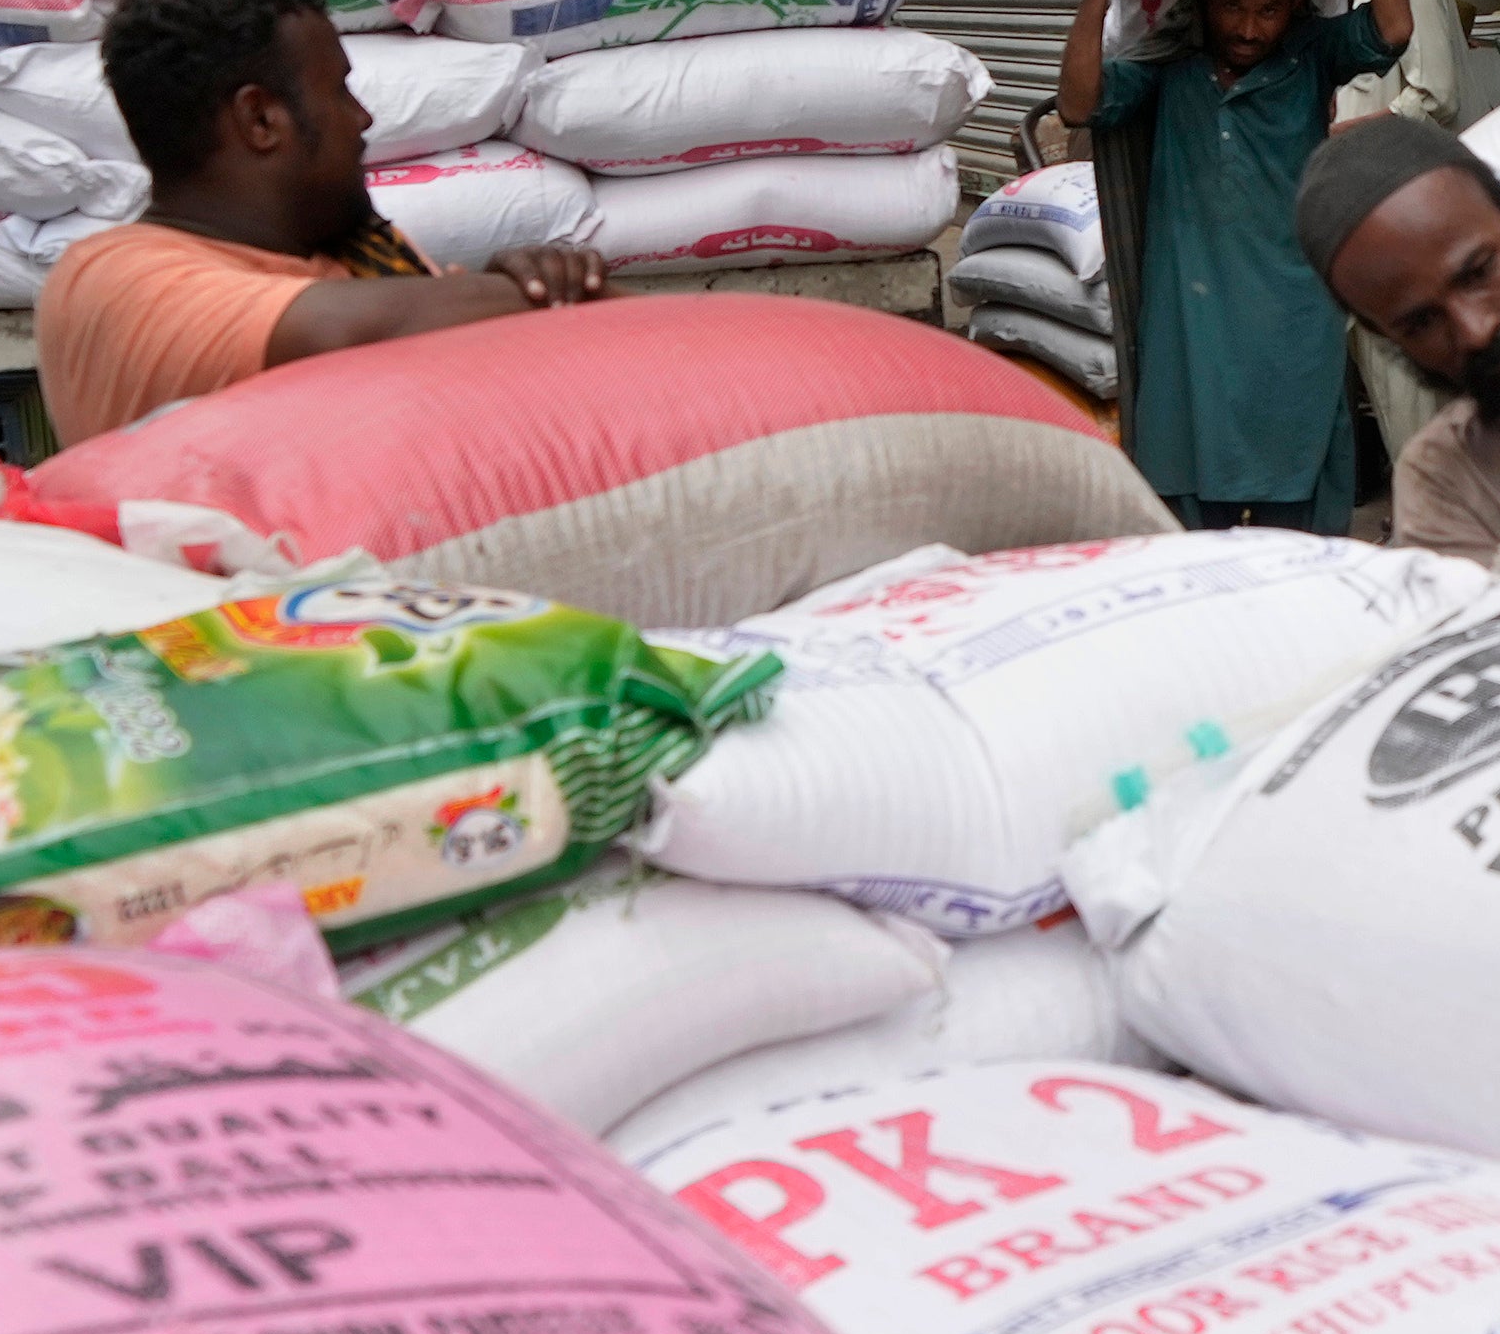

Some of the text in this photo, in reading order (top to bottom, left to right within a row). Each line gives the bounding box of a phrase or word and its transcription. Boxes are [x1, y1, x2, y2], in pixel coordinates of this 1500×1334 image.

[675, 1108, 1068, 1291] PK
[1028, 1074, 1245, 1157] 2
[914, 1163, 1269, 1303] BRAND
[42, 1218, 361, 1304] VIP
